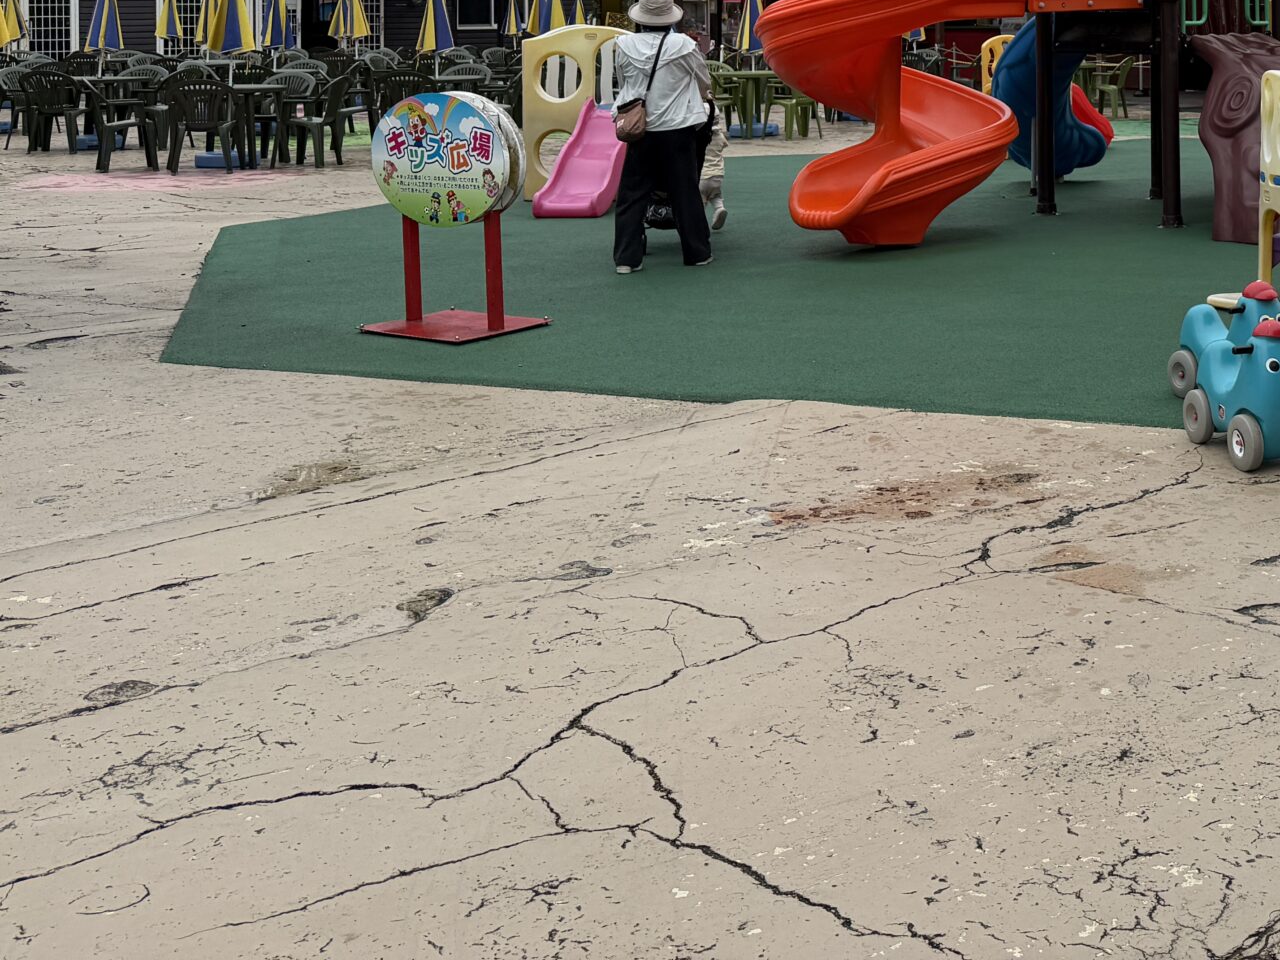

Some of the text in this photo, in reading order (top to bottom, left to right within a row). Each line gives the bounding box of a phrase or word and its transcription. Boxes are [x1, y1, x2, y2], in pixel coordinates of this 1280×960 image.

[385, 127, 493, 174] キッズ広場
